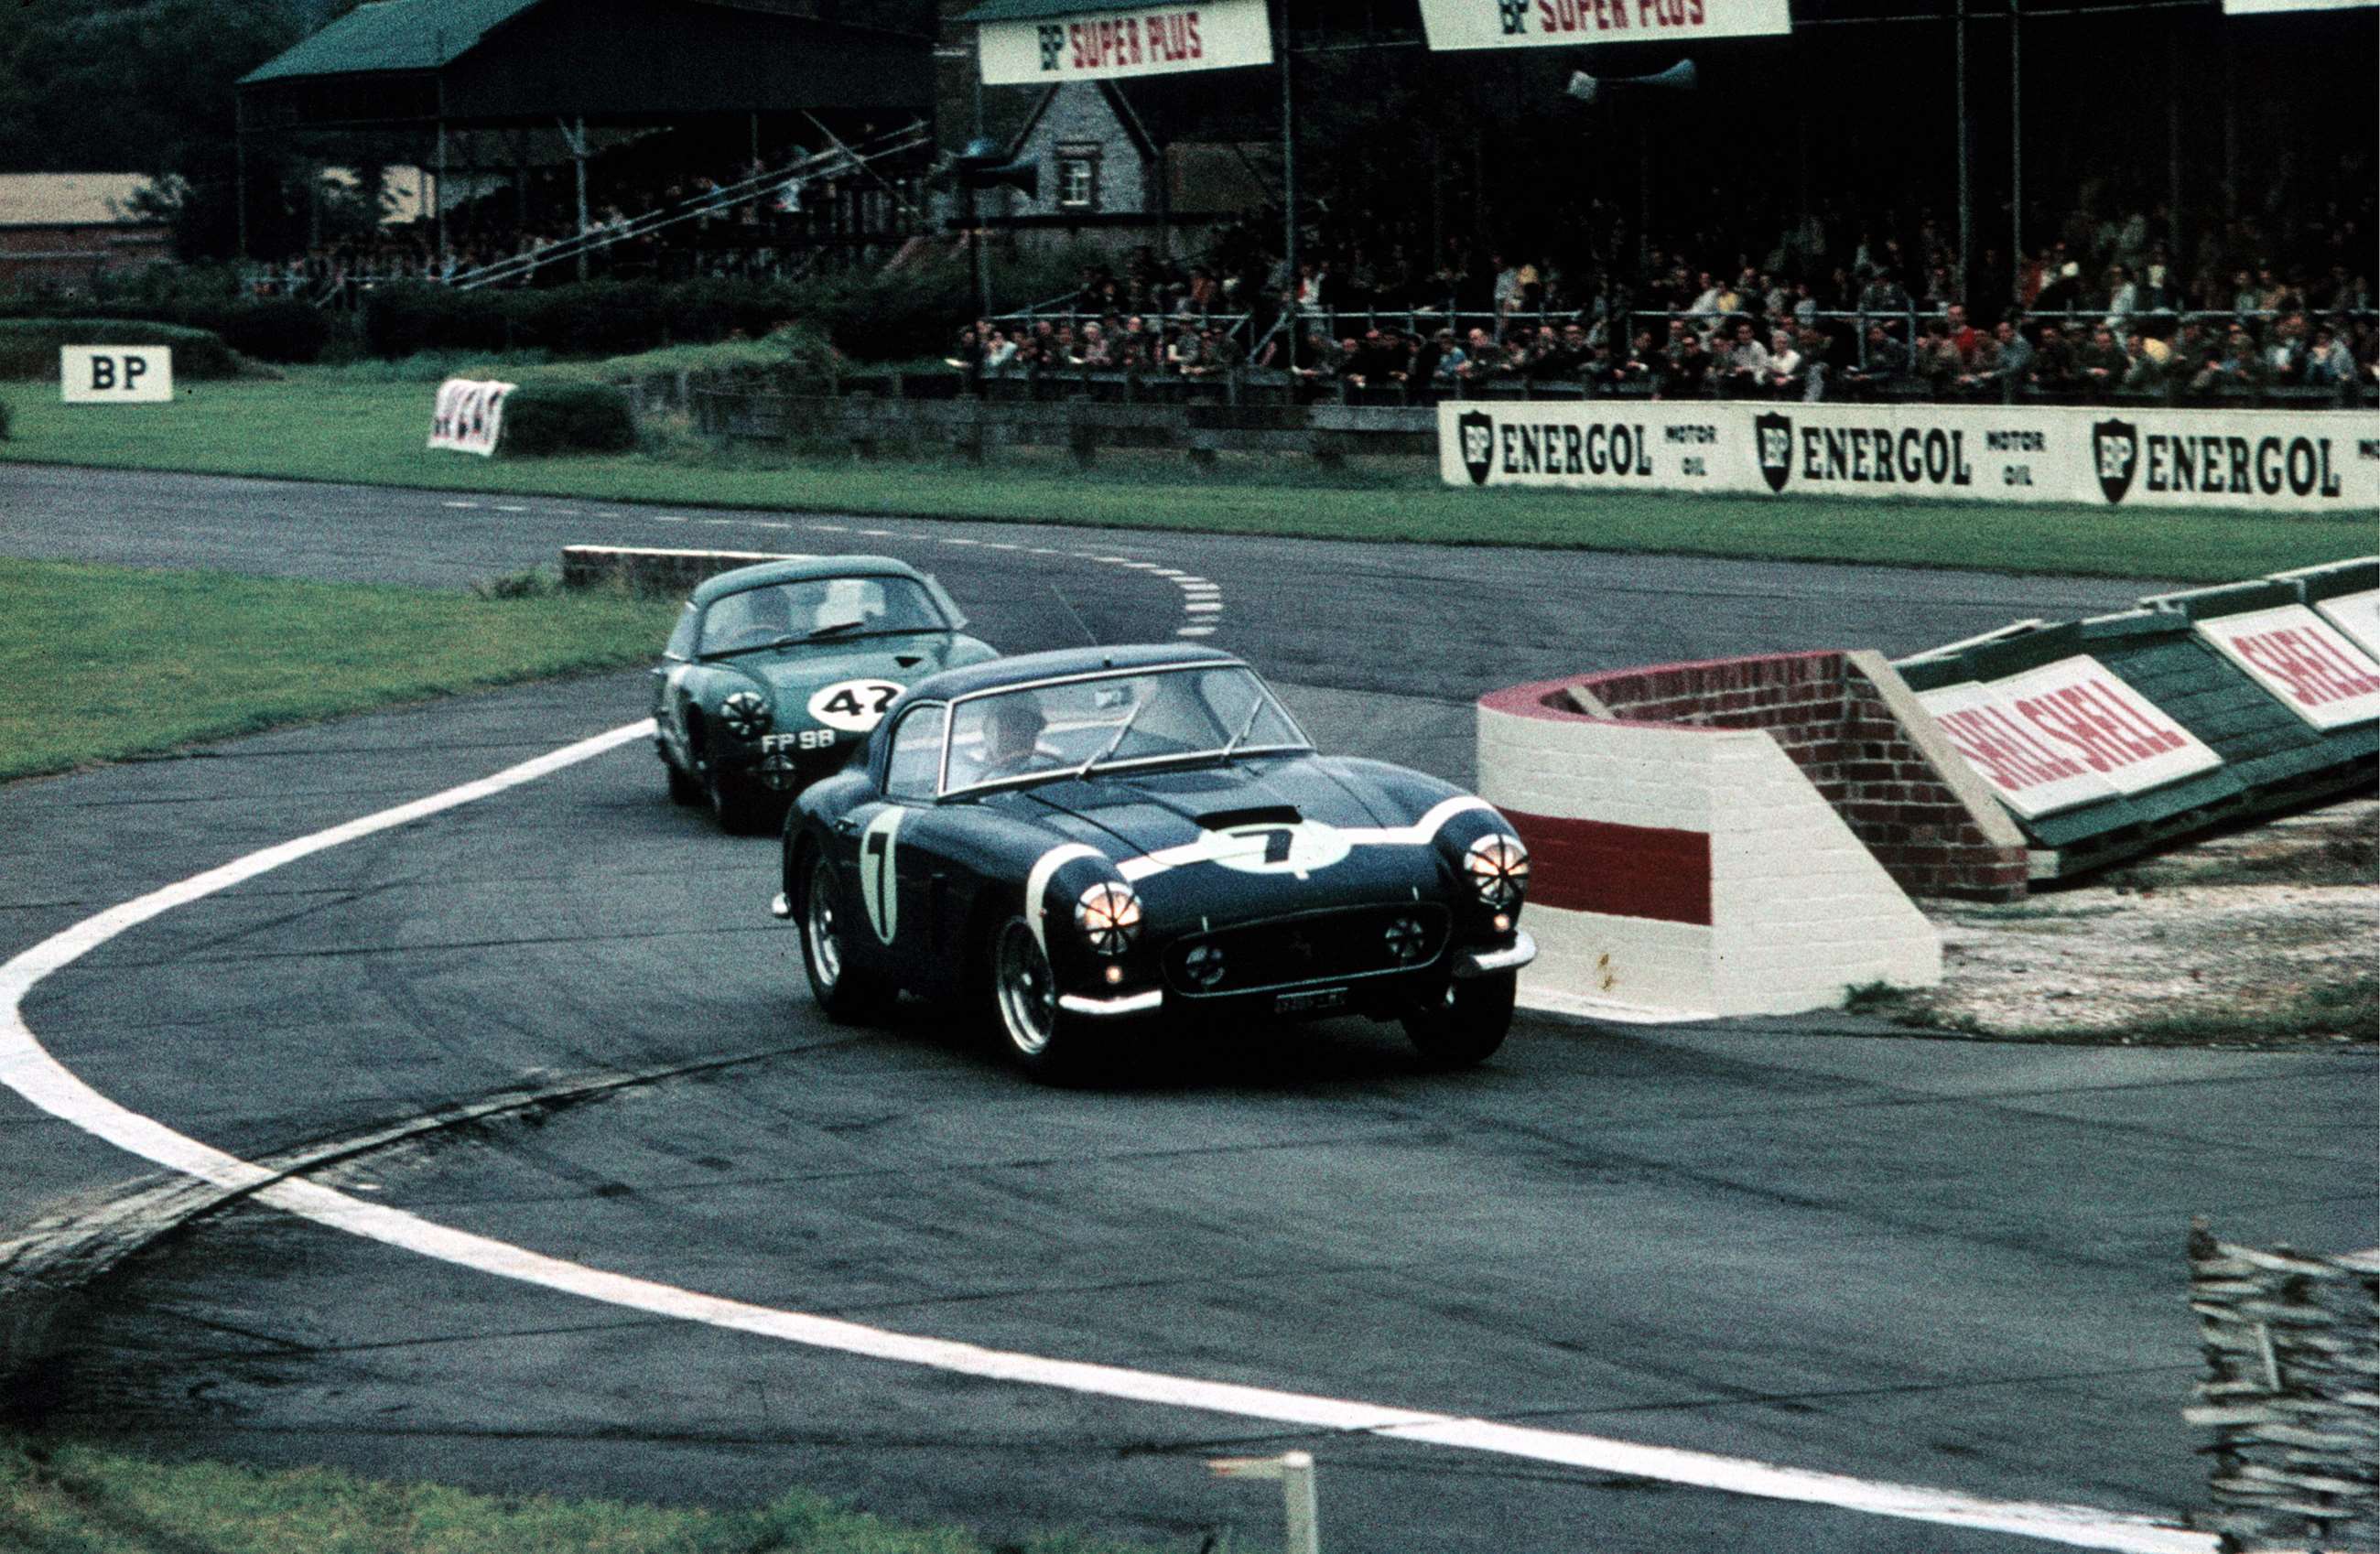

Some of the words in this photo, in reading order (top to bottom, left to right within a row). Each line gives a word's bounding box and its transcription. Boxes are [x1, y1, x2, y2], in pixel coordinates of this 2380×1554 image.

[1038, 24, 1065, 70] BP
[1070, 17, 1142, 70] SUPER
[1146, 12, 1202, 62] PLUS
[90, 355, 147, 391] BP
[1500, 423, 1652, 476] ENERGOL
[1665, 425, 1717, 444] MOTOR
[1801, 426, 1972, 486] ENERGOL
[1986, 430, 2045, 451] MOTOR
[1682, 458, 1707, 477] OIL
[2005, 464, 2034, 486] OIL
[2099, 436, 2134, 479] BP
[2147, 435, 2342, 497] ENERGOL
[2231, 626, 2379, 707] SHELL
[762, 733, 795, 754] FP
[2017, 678, 2188, 772] SHELL
[1229, 828, 1294, 864] 7
[867, 831, 890, 939] 7
